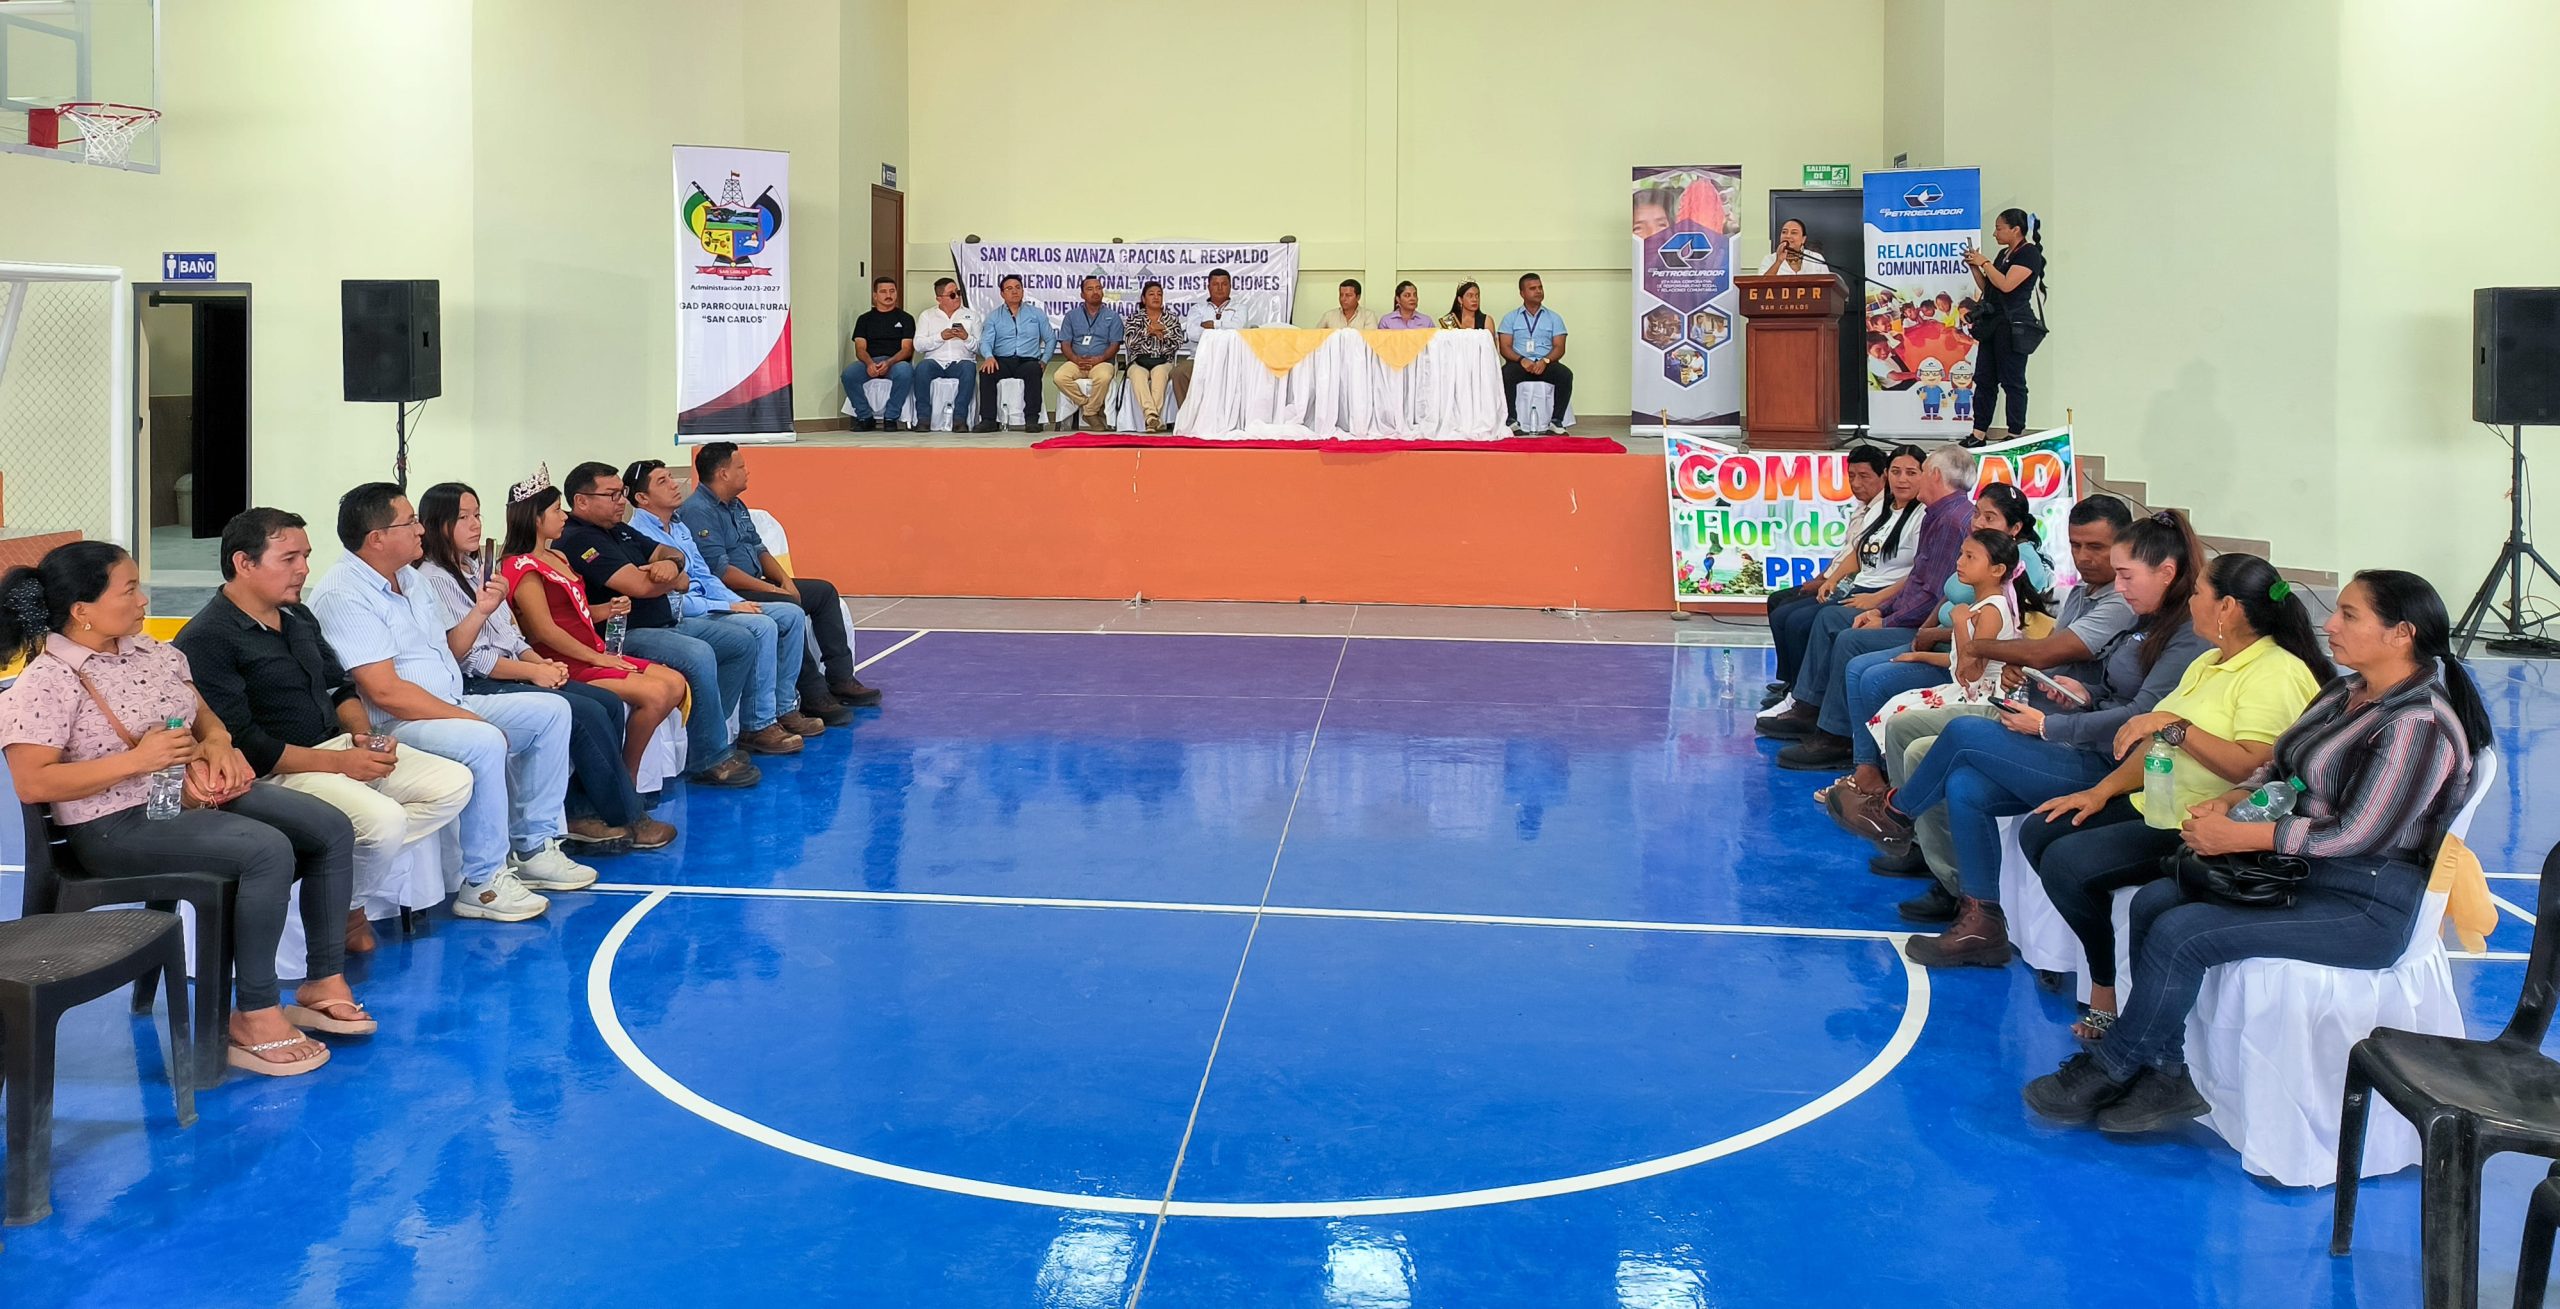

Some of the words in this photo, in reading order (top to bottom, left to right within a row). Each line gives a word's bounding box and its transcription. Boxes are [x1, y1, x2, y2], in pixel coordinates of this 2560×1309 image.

[1884, 208, 1964, 218] PETROECUADOR
[980, 246, 1007, 262] SAN
[1010, 247, 1062, 263] CARLOS
[1065, 248, 1115, 263] AVANZA
[1120, 249, 1175, 264] GRACIAS
[1179, 249, 1196, 264] AL
[1200, 249, 1269, 264] RESPALDO
[1877, 242, 1968, 259] RELACIONES
[180, 257, 215, 273] BAÑO
[1877, 260, 1970, 276] COMUNITARIAS
[969, 273, 993, 289] DEL
[1067, 275, 1133, 290] NAONAL
[1137, 275, 1146, 290] Y
[1178, 275, 1280, 291] INSTCIONES
[679, 302, 699, 310] GAD
[701, 303, 759, 311] PARROQUIAL
[760, 303, 788, 311] RURAL
[1793, 511, 1847, 547] de
